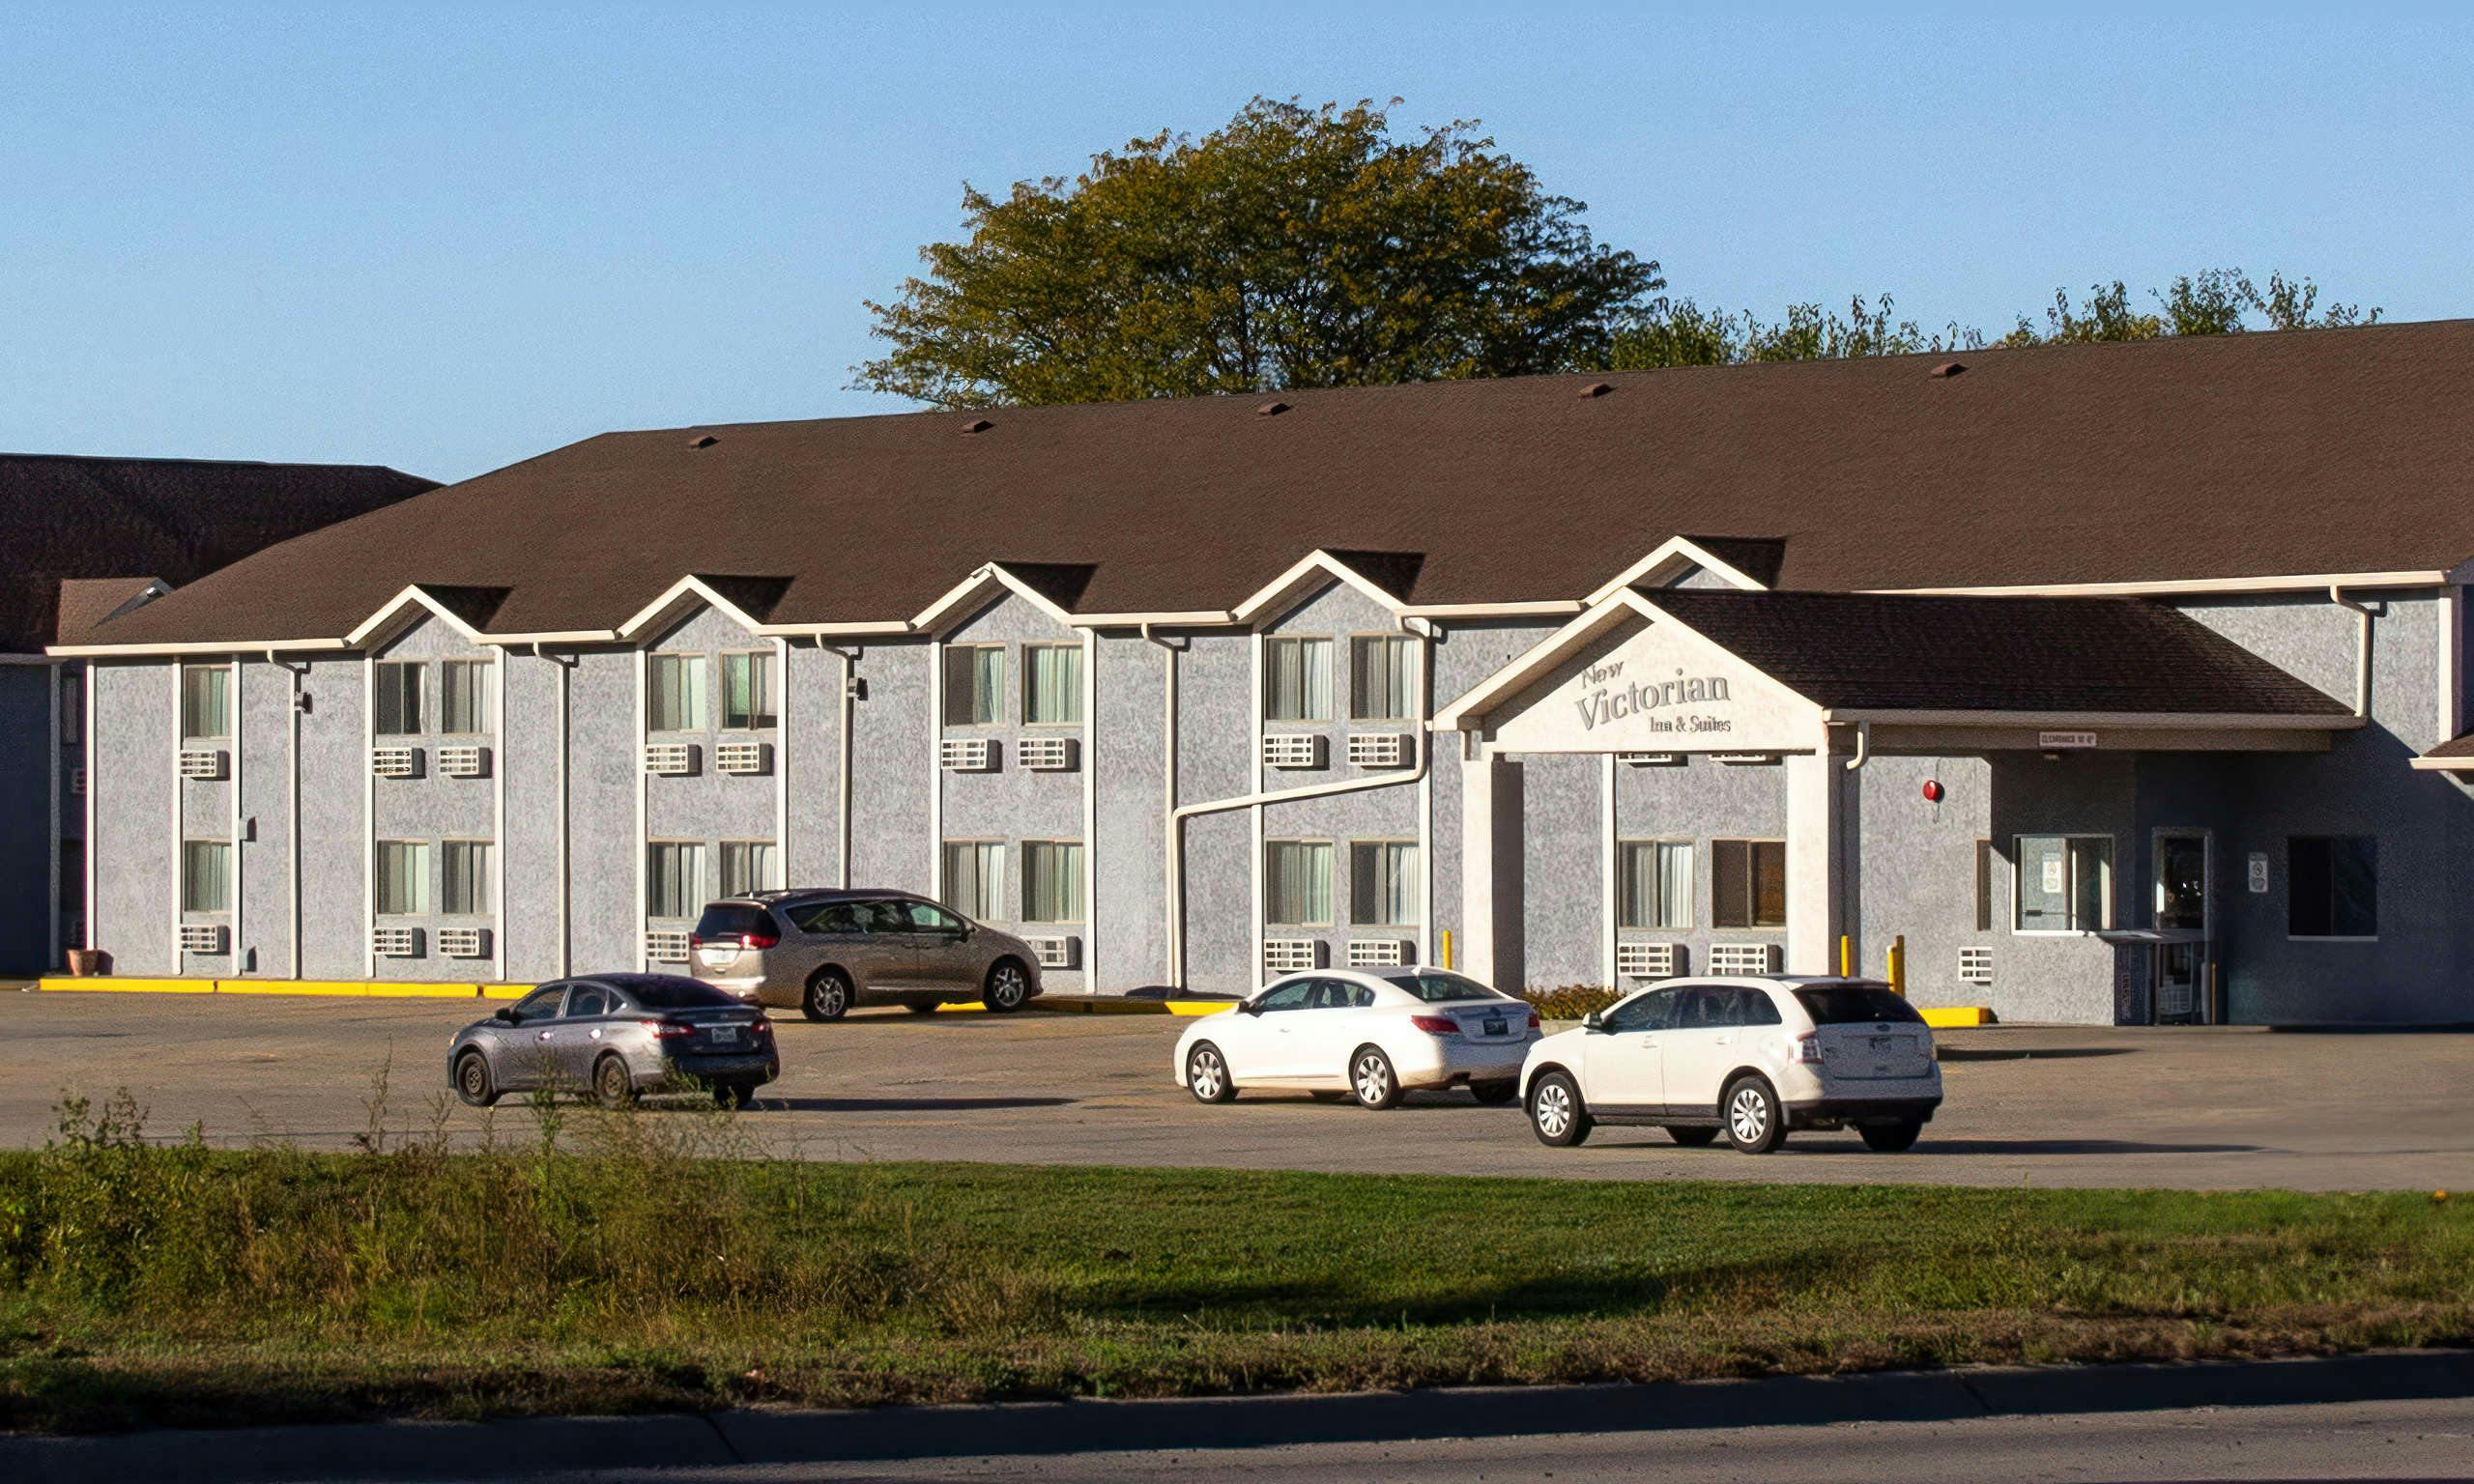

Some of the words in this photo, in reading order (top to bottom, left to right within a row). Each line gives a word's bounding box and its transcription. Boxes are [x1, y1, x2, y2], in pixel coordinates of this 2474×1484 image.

[1580, 661, 1625, 689] New
[1574, 668, 1732, 730] Victorian
[1650, 716, 1673, 732] Inn
[1676, 716, 1686, 732] &
[1689, 715, 1731, 732] Suites
